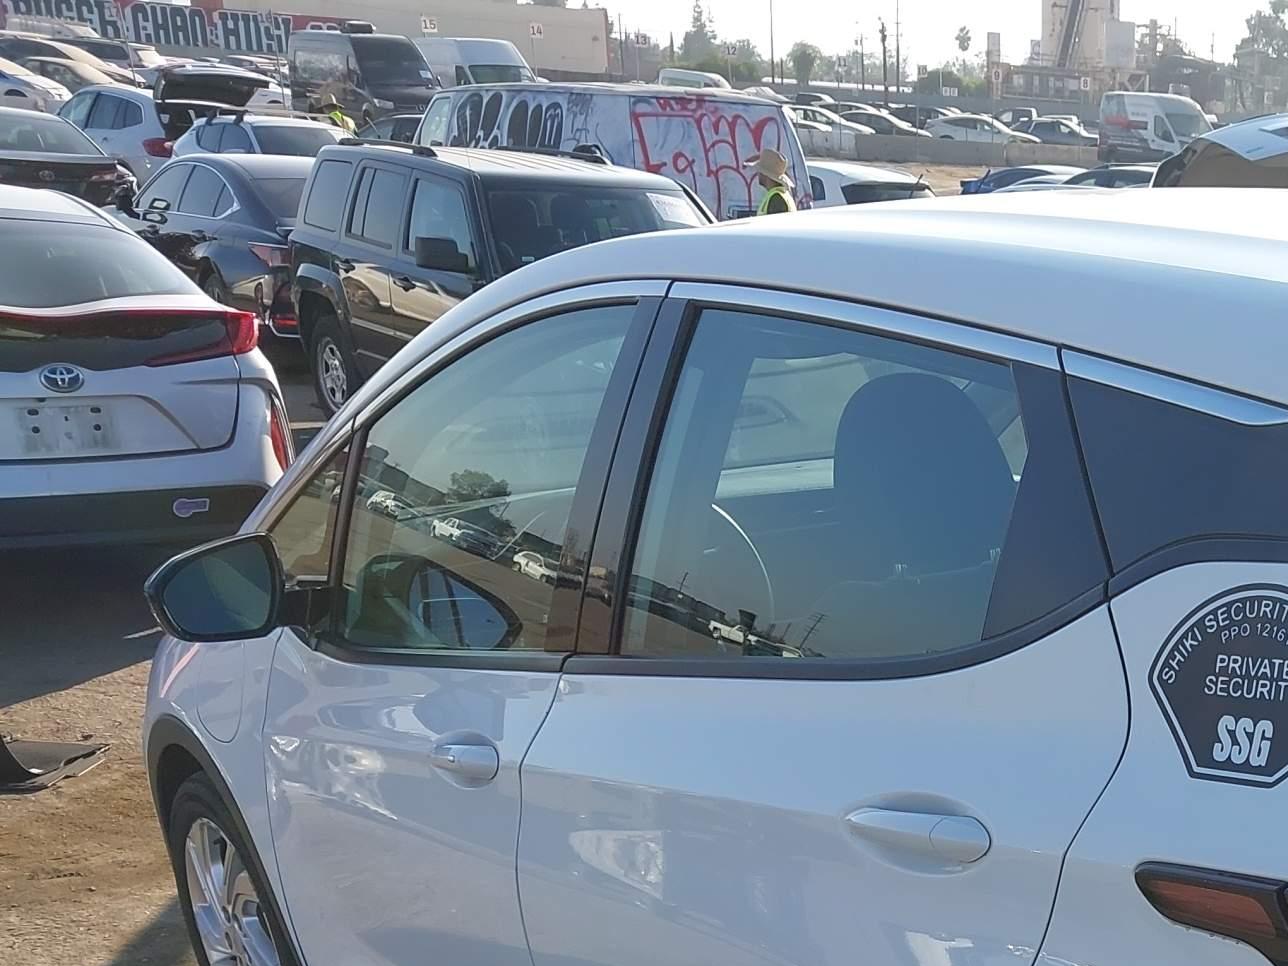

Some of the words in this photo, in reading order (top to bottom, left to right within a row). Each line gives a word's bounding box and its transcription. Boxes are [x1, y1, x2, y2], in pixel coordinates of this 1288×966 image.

[422, 18, 437, 30] 15
[530, 25, 543, 36] 14
[635, 34, 648, 46] 13
[726, 45, 737, 56] 12
[1220, 623, 1251, 644] PPO
[1162, 625, 1204, 684] SHIKI
[1212, 714, 1275, 768] SSG
